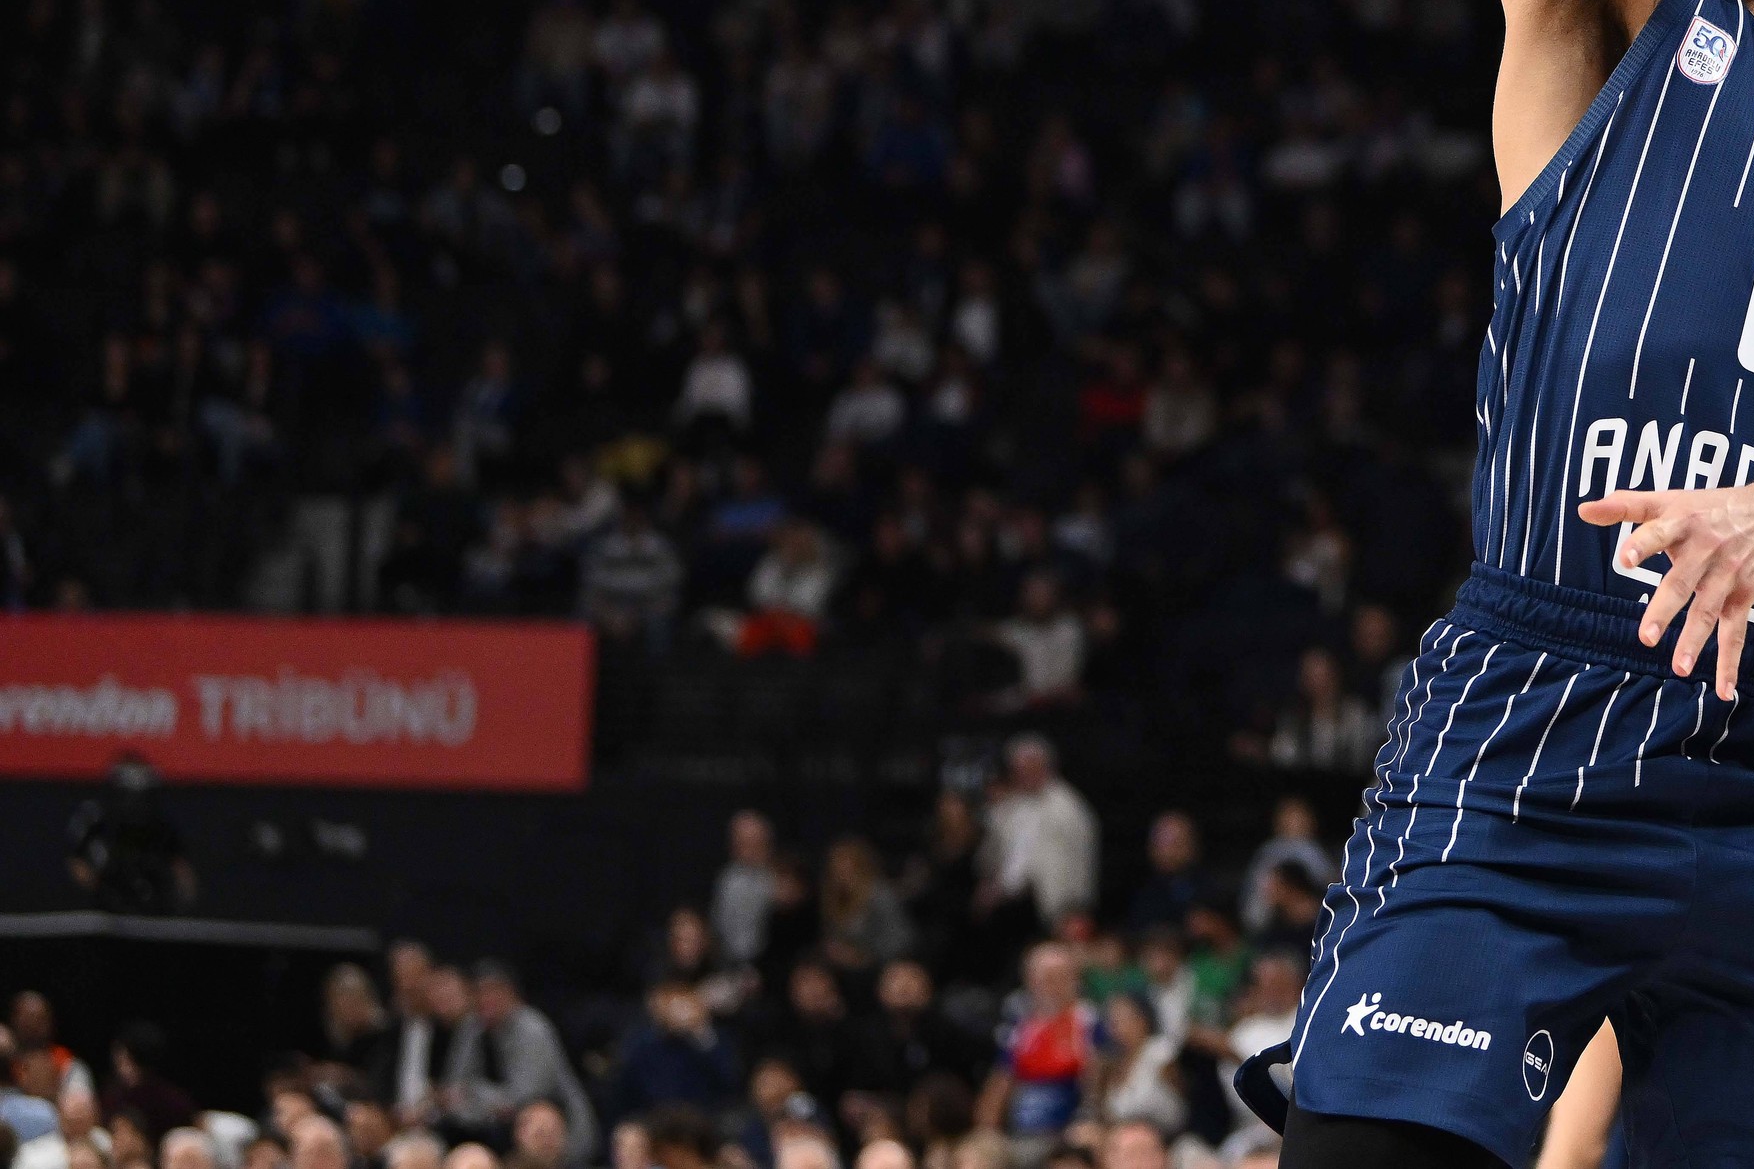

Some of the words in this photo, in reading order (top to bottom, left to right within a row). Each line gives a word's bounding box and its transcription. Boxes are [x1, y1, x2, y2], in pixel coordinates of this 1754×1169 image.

[1687, 57, 1714, 75] EFES
[1369, 1010, 1493, 1051] corendon
[1524, 1051, 1549, 1077] GSA
